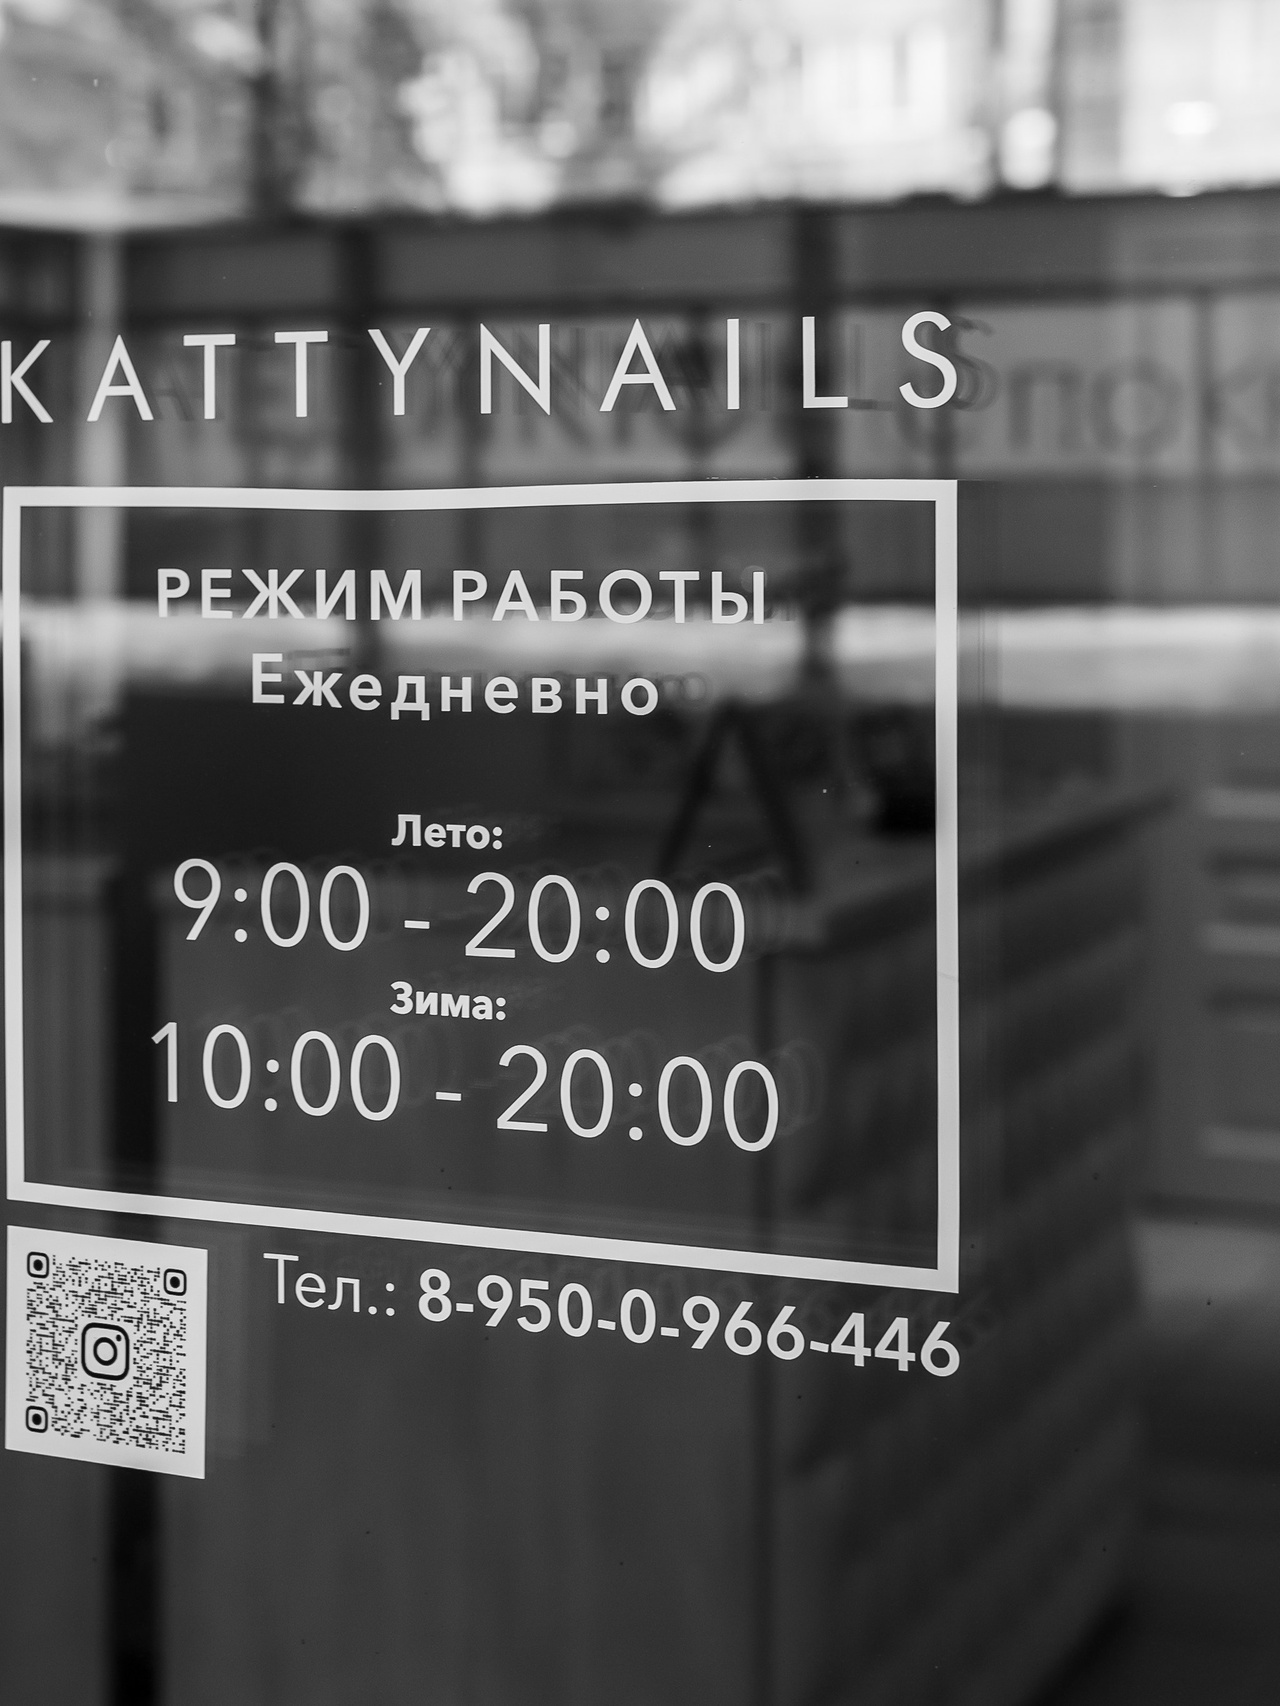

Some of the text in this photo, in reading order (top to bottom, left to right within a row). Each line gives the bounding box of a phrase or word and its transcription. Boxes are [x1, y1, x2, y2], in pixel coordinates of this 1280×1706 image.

[0, 310, 958, 425] KATTYNAILS
[156, 568, 766, 625] РЕЖИМ РАБОТЫ
[251, 652, 660, 721] Ежедневно
[391, 813, 504, 853] Лето:
[173, 858, 746, 973] 9:00 - 20:00
[389, 981, 507, 1021] Зима:
[150, 1021, 780, 1152] 10:00 - 20:00
[263, 1252, 961, 1377] Тел.: 8-950-0-966-446
